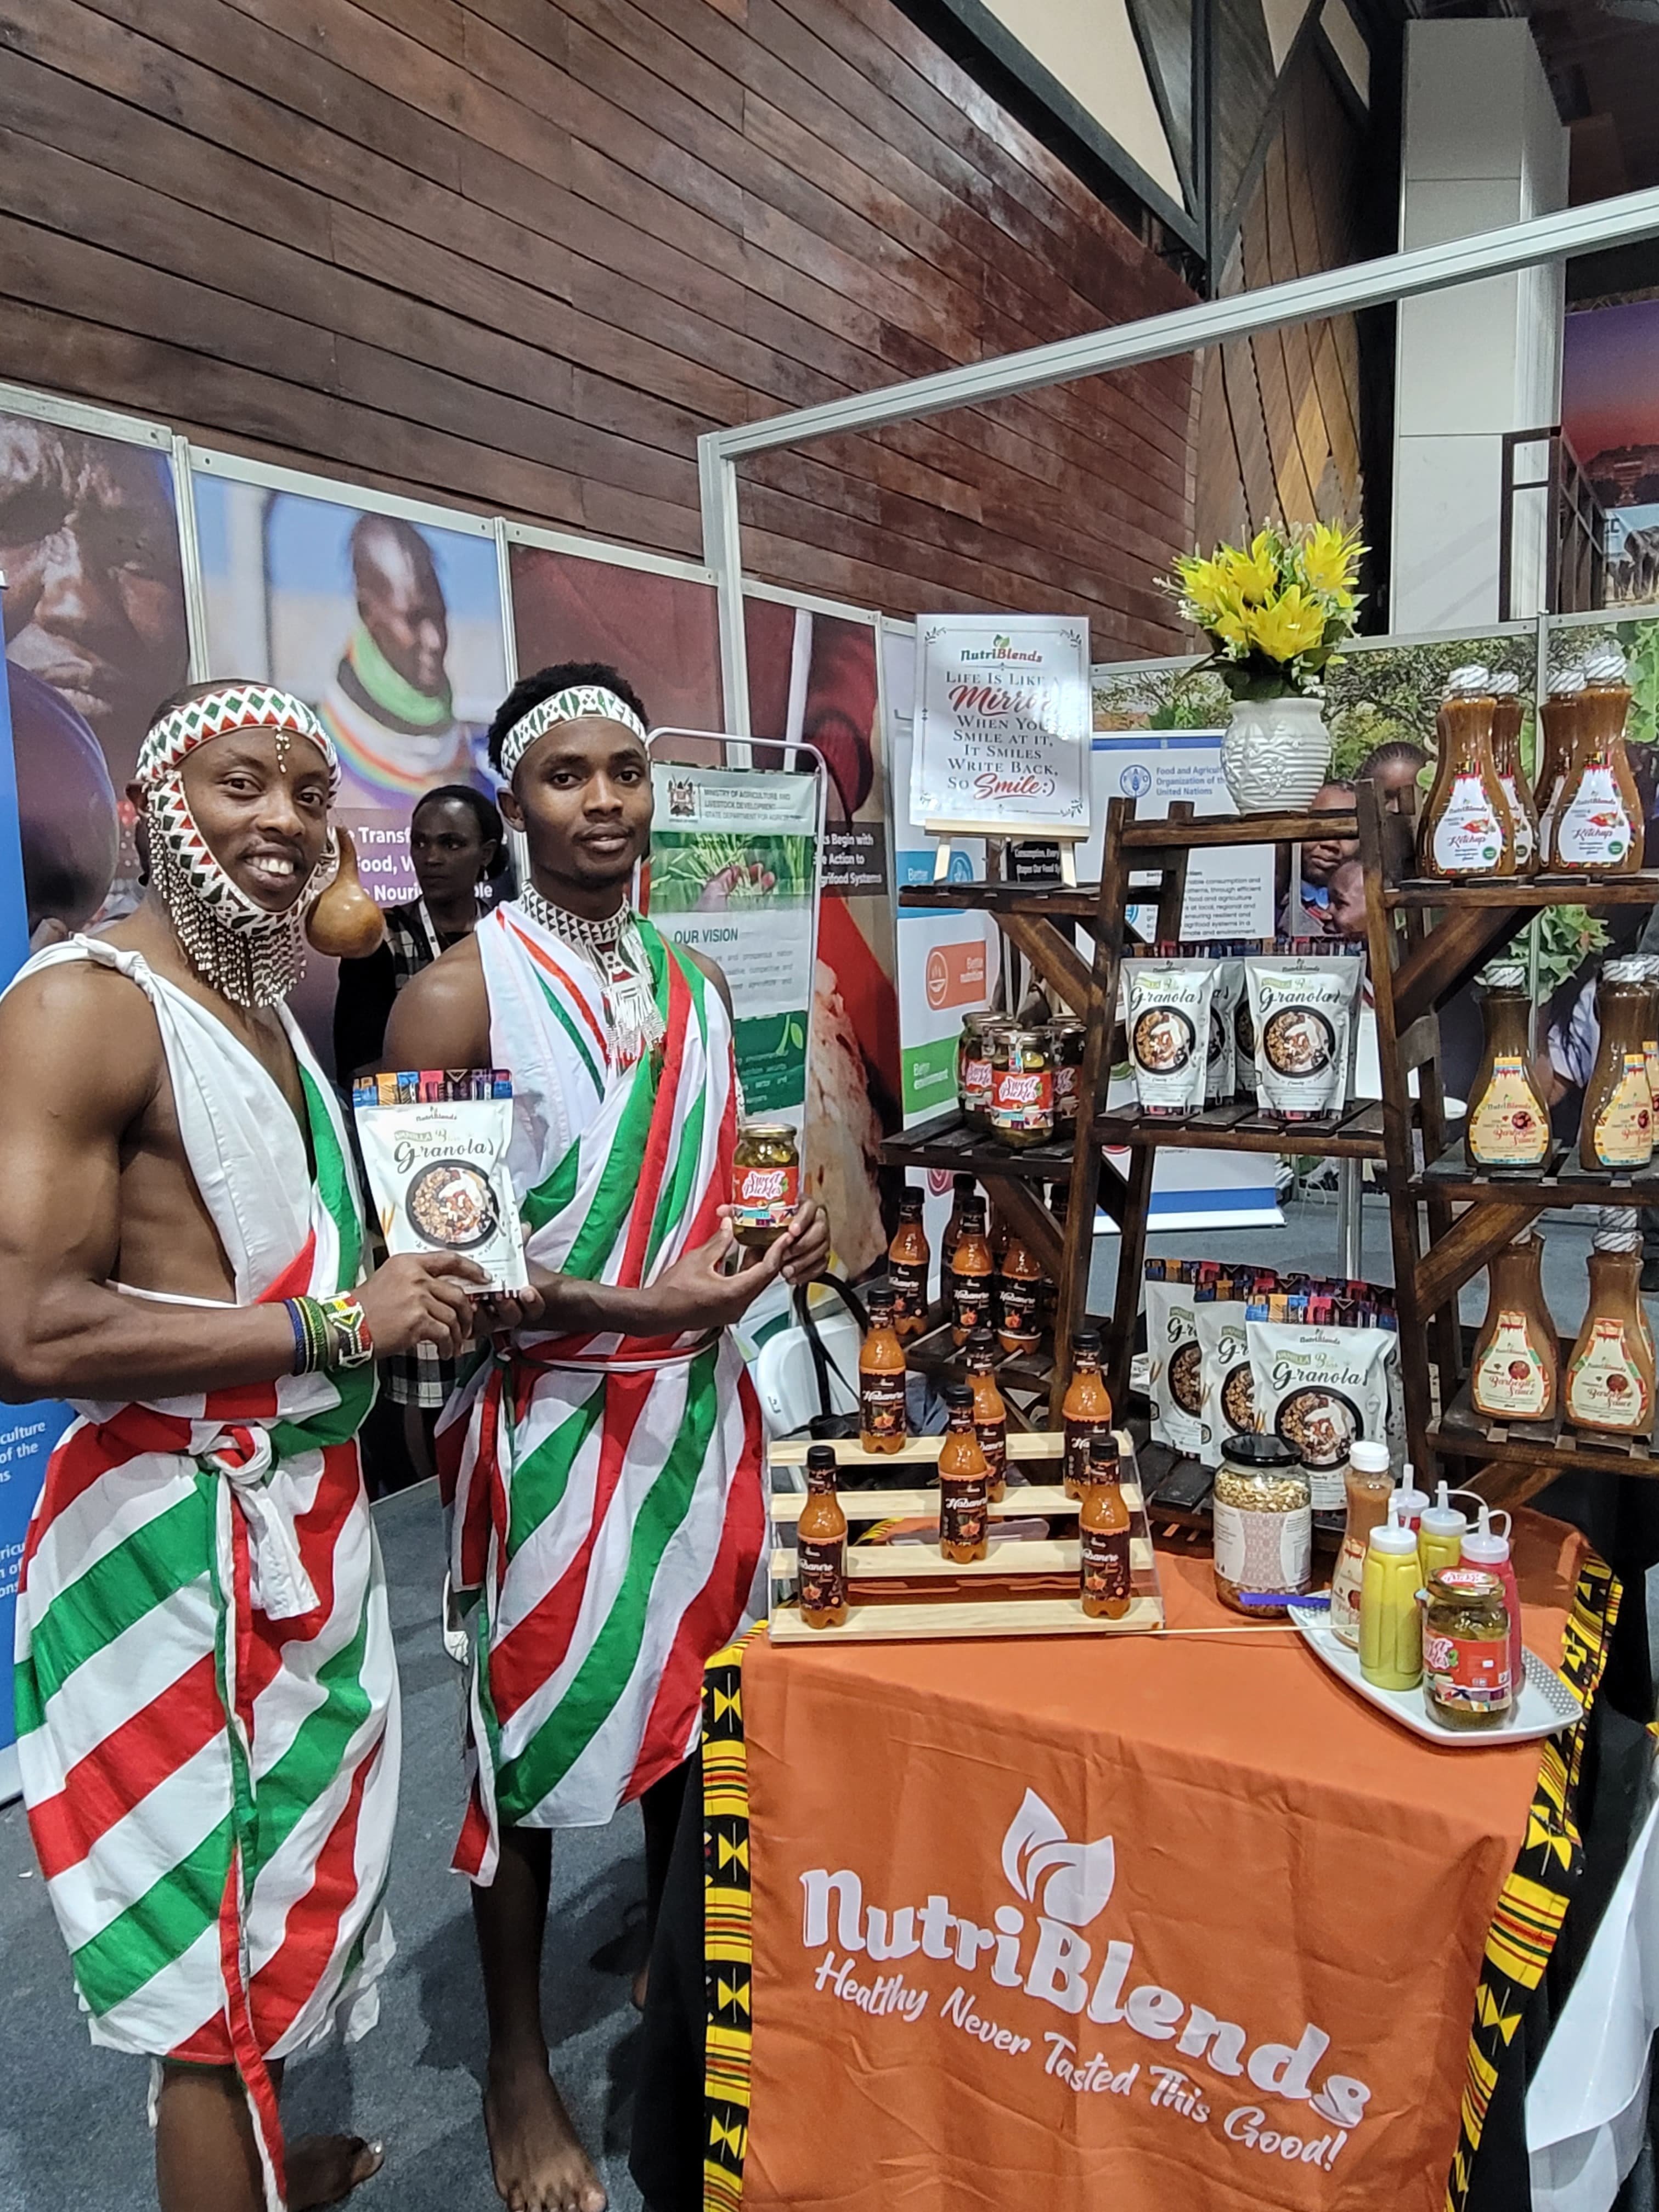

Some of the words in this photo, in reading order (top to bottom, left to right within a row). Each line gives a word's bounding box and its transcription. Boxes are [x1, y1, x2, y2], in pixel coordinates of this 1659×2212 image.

[946, 671, 981, 684] LIFE
[988, 673, 1002, 685] IS
[957, 715, 1009, 729] WHEN
[953, 730, 1002, 743] SMILE
[986, 745, 1041, 759] SMILES
[948, 758, 1004, 772] WRITE
[1156, 766, 1175, 775] Food
[1177, 766, 1190, 775] and
[1193, 766, 1220, 776] Agricul
[1156, 777, 1205, 787] Organization
[1207, 776, 1215, 784] of
[1217, 776, 1225, 784] th
[1156, 788, 1182, 796] United
[357, 827, 411, 843] Transf
[831, 833, 855, 848] Begin
[855, 832, 874, 845] with
[1447, 834, 1486, 848] Ketchup
[1572, 827, 1613, 841] Ketchup
[828, 852, 855, 865] Action
[855, 853, 865, 865] to
[820, 871, 849, 888] grifood
[850, 871, 882, 887] Systems
[374, 884, 422, 901] Nouri
[1211, 921, 1238, 929] systems
[674, 930, 699, 944] OUR
[702, 928, 738, 943] VISION
[1130, 986, 1196, 1011] Granola
[393, 1138, 489, 1174] Granola
[749, 1172, 783, 1185] Sweet
[1277, 1351, 1311, 1365] VANILLA
[1272, 1361, 1363, 1391] Granola
[862, 1390, 905, 1402] Habanero
[0, 1447, 13, 1464] of
[16, 1442, 39, 1459] the
[799, 1558, 834, 1572] abanero
[814, 1950, 929, 2022] Healthy
[940, 1986, 1032, 2056] Never
[1044, 2032, 1140, 2096] Tasted
[1149, 2065, 1211, 2123] This
[1223, 2106, 1348, 2172] Good!
